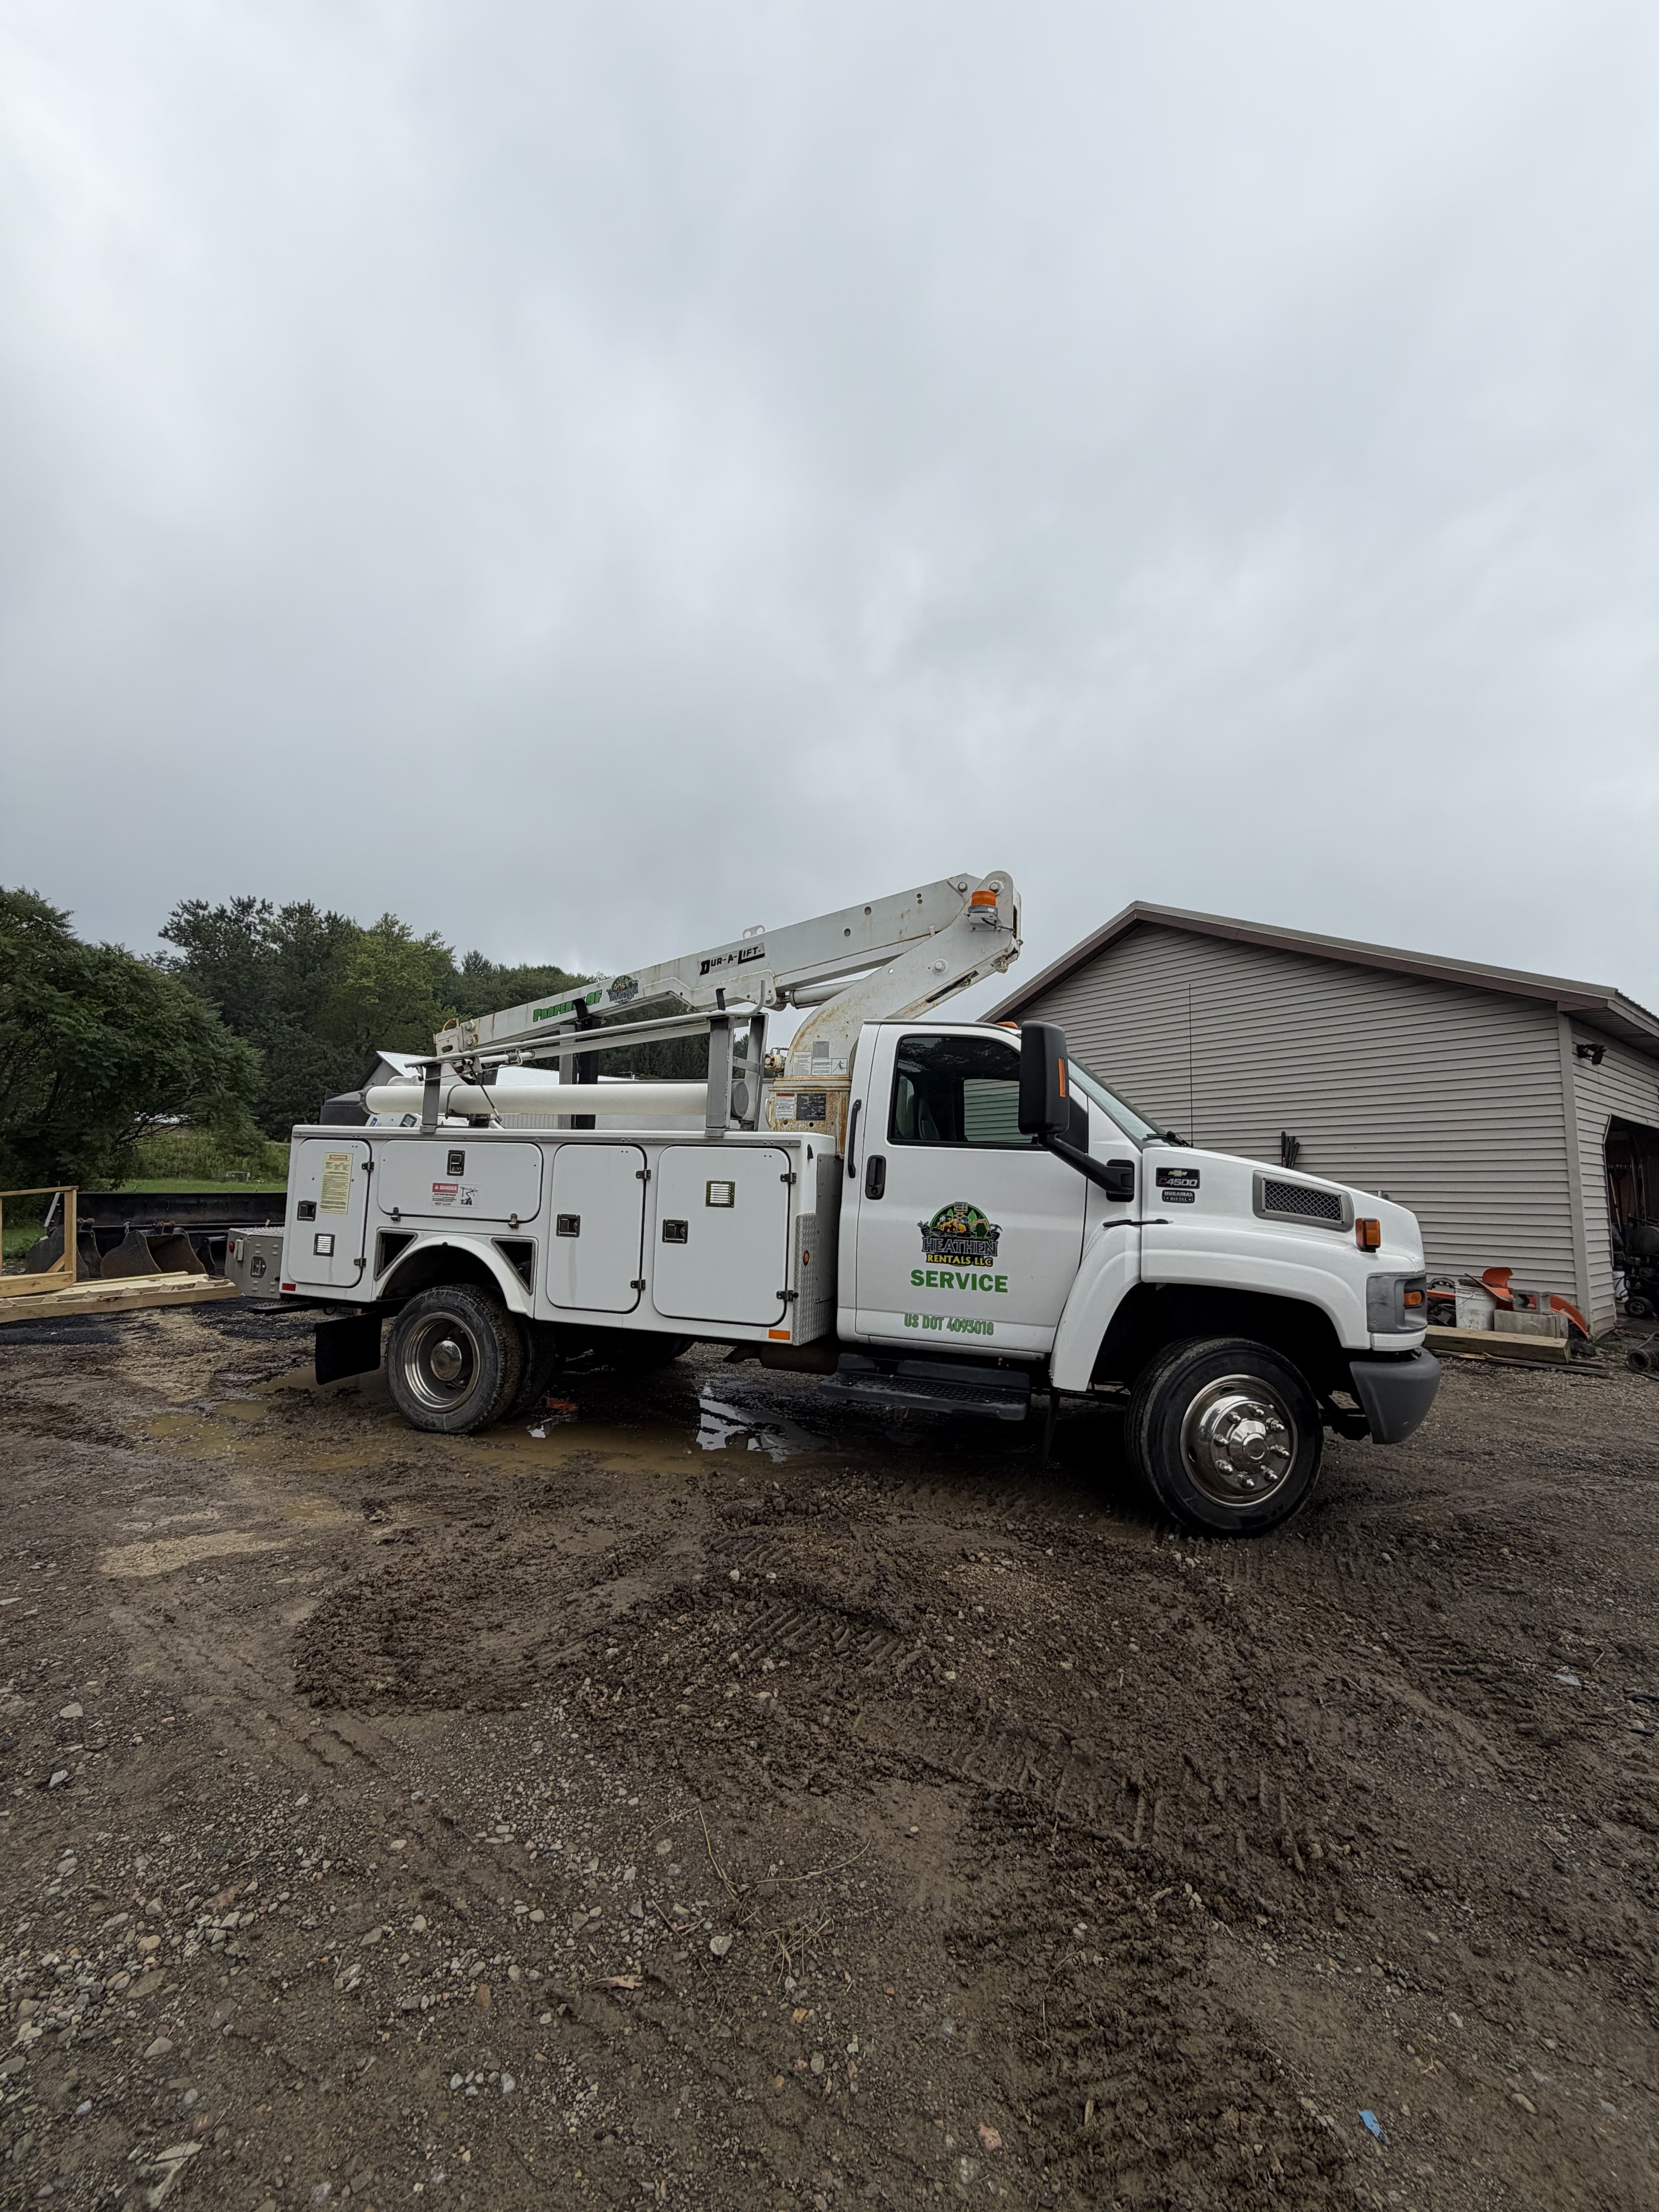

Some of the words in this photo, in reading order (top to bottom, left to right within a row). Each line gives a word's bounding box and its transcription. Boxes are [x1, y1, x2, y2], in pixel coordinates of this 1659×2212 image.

[533, 996, 585, 1023] PROPER
[586, 989, 602, 1006] OF
[1158, 1178, 1198, 1186] C4500
[922, 1237, 998, 1256] HEATHEN
[927, 1254, 971, 1265] RENTALS
[974, 1256, 993, 1266] LLC
[910, 1269, 1008, 1293] SERVICE
[904, 1313, 919, 1328] US
[922, 1316, 944, 1330] DOT
[946, 1318, 994, 1335] 4093018
